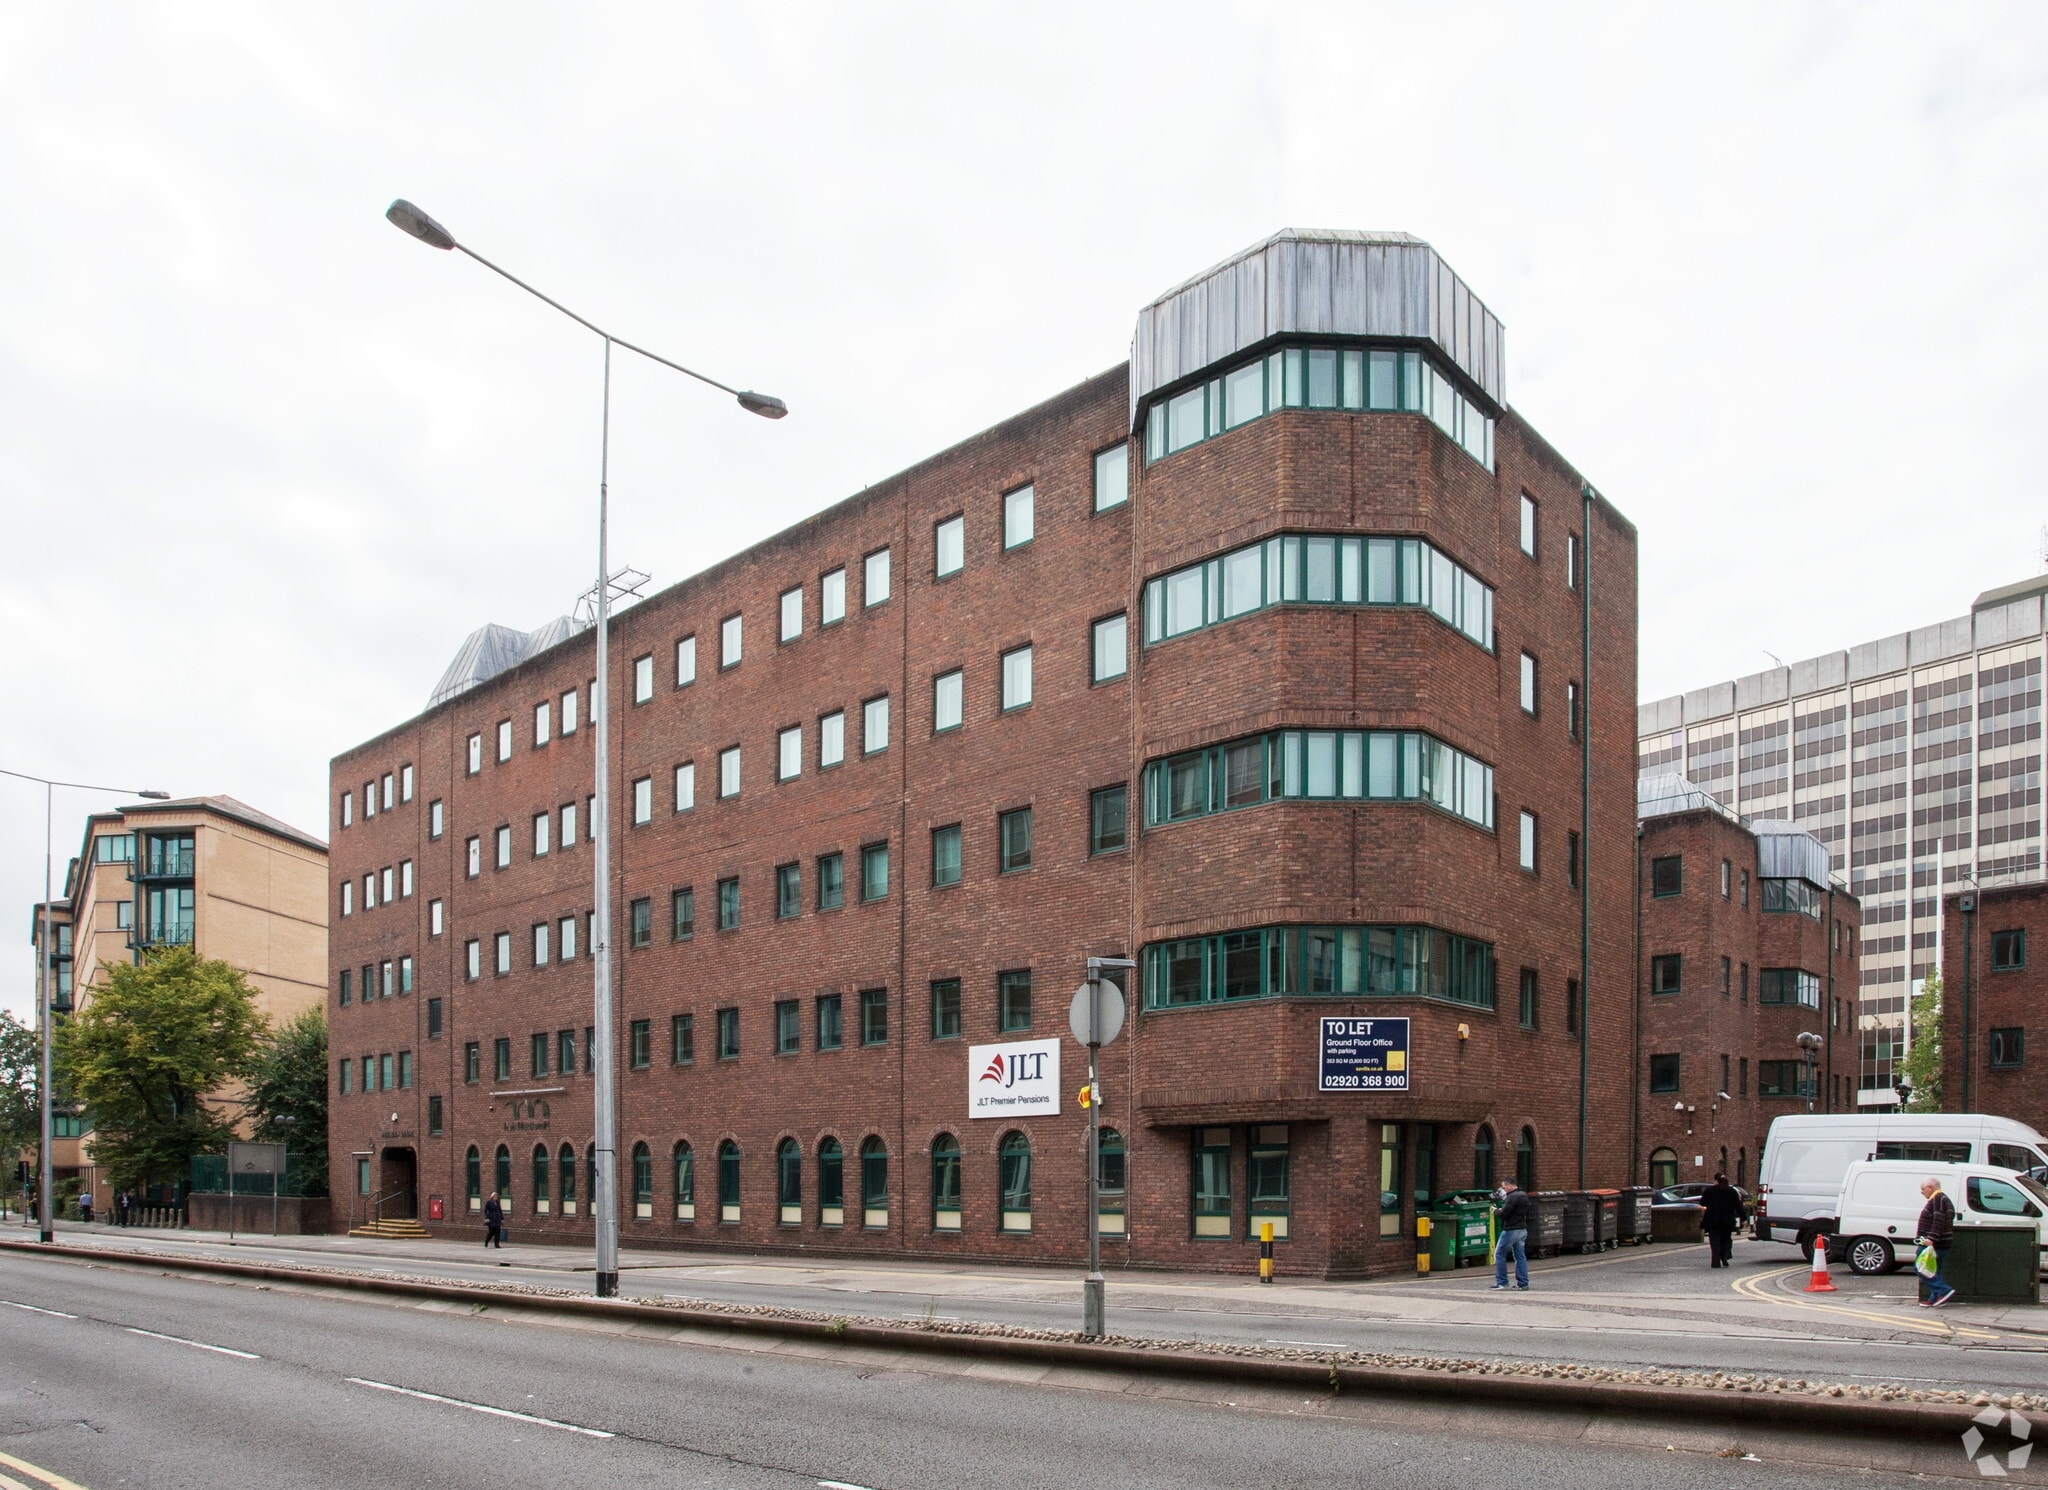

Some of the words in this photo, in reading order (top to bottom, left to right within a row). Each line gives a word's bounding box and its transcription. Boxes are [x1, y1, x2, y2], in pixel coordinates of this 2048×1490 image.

[1327, 1022, 1345, 1035] TO
[1349, 1022, 1373, 1035] LET
[1372, 1039, 1393, 1047] Office
[1005, 1052, 1049, 1088] JLT
[1325, 1076, 1359, 1086] 02920
[1361, 1076, 1382, 1086] 368
[1384, 1076, 1405, 1086] 900
[977, 1097, 989, 1106] JLT
[990, 1096, 1016, 1106] Premier
[1018, 1094, 1050, 1104] Pensions
